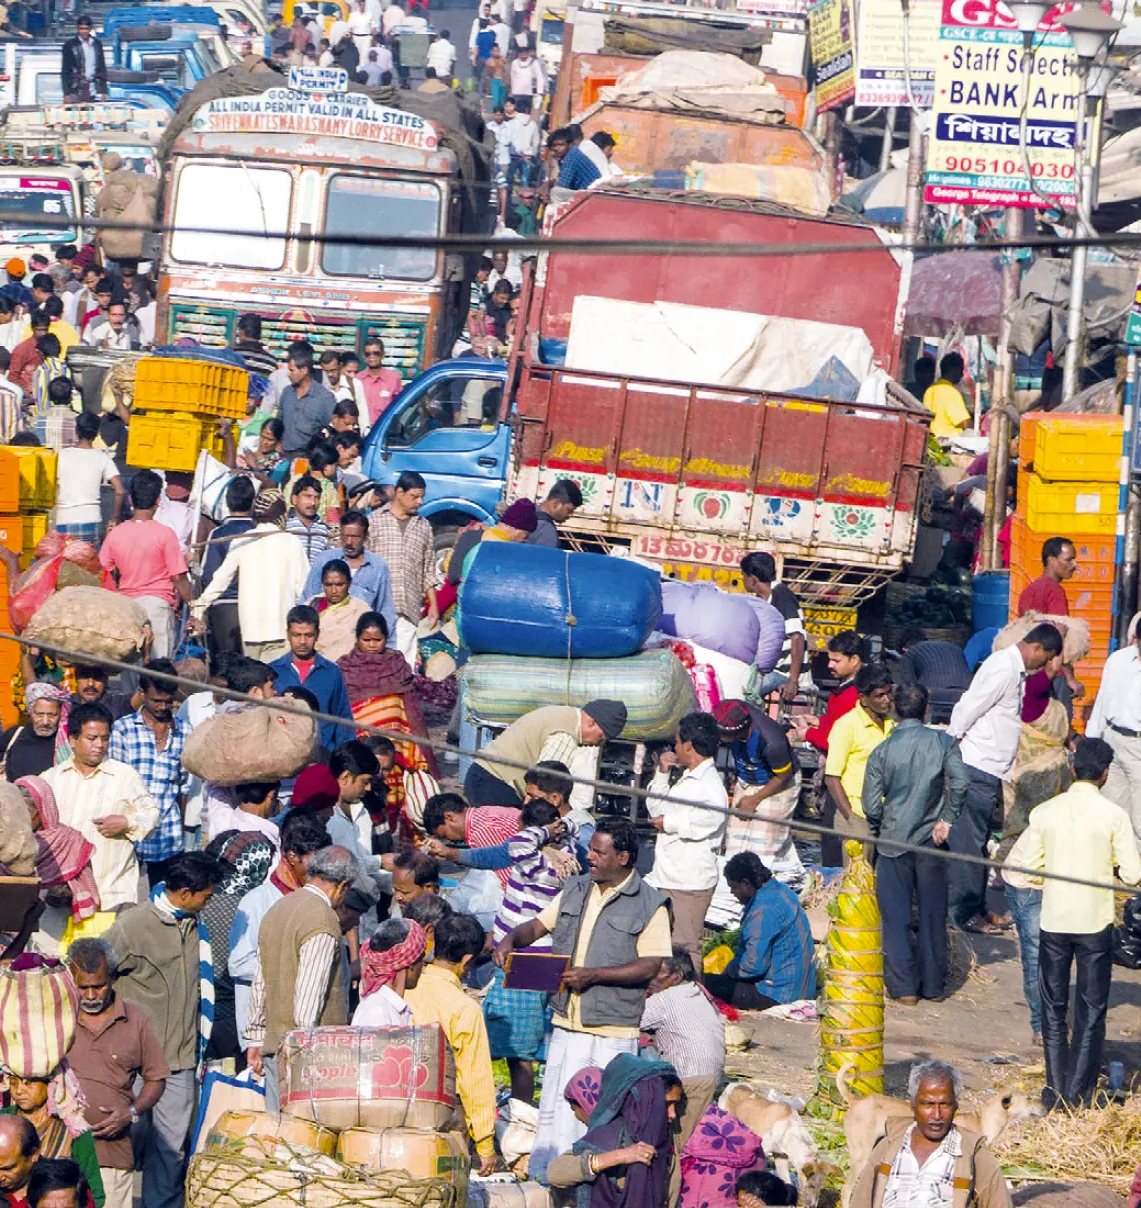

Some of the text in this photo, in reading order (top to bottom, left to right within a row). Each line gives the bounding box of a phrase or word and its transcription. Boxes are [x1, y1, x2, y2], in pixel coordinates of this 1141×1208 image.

[952, 45, 1000, 72] Staff
[300, 79, 336, 89] PERMIT
[950, 80, 1019, 108] BANK
[268, 90, 370, 106] GOODS CARRIER
[209, 101, 425, 129] ALL INDIA PERMIT VALID IN ALL STATES
[933, 187, 969, 199] George
[971, 190, 1020, 203] Telegraph
